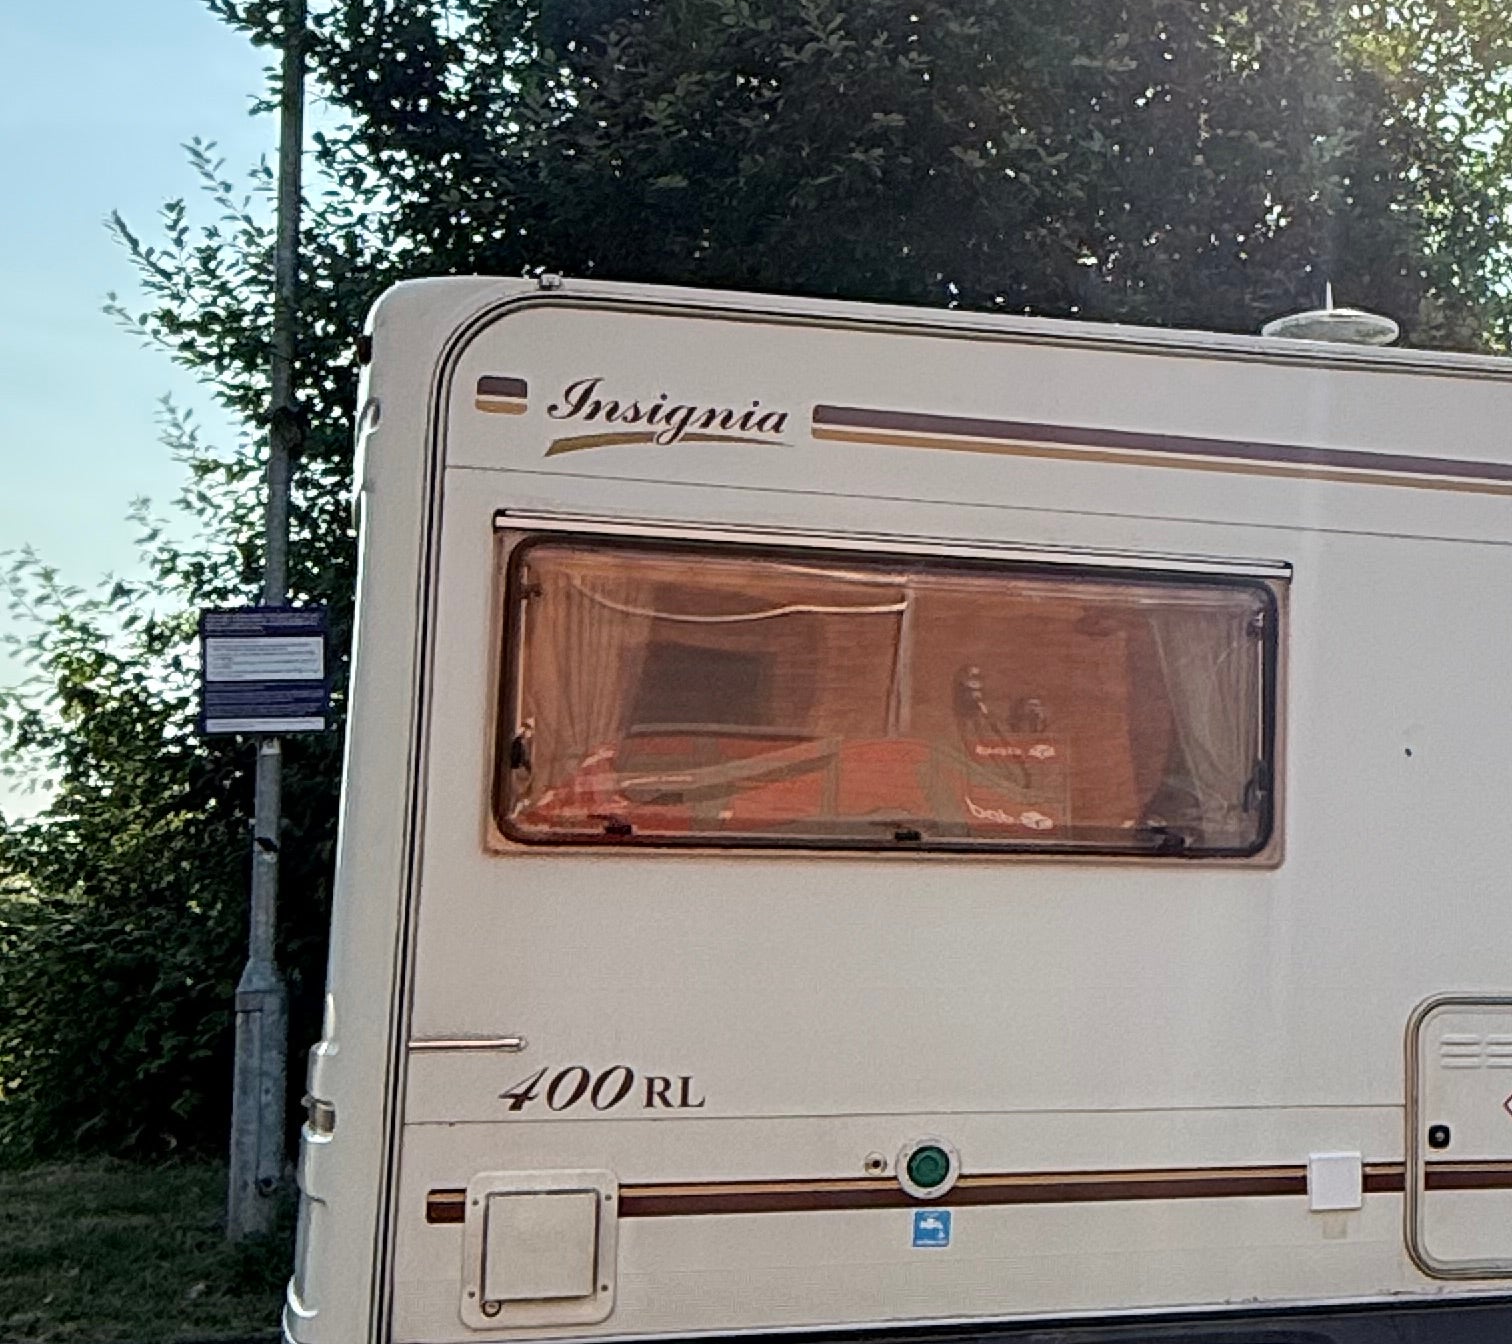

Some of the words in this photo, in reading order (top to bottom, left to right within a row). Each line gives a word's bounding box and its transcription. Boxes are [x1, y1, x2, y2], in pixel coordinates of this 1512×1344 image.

[547, 377, 788, 445] Insignia
[499, 1065, 634, 1111] 400
[643, 1075, 705, 1108] RL
